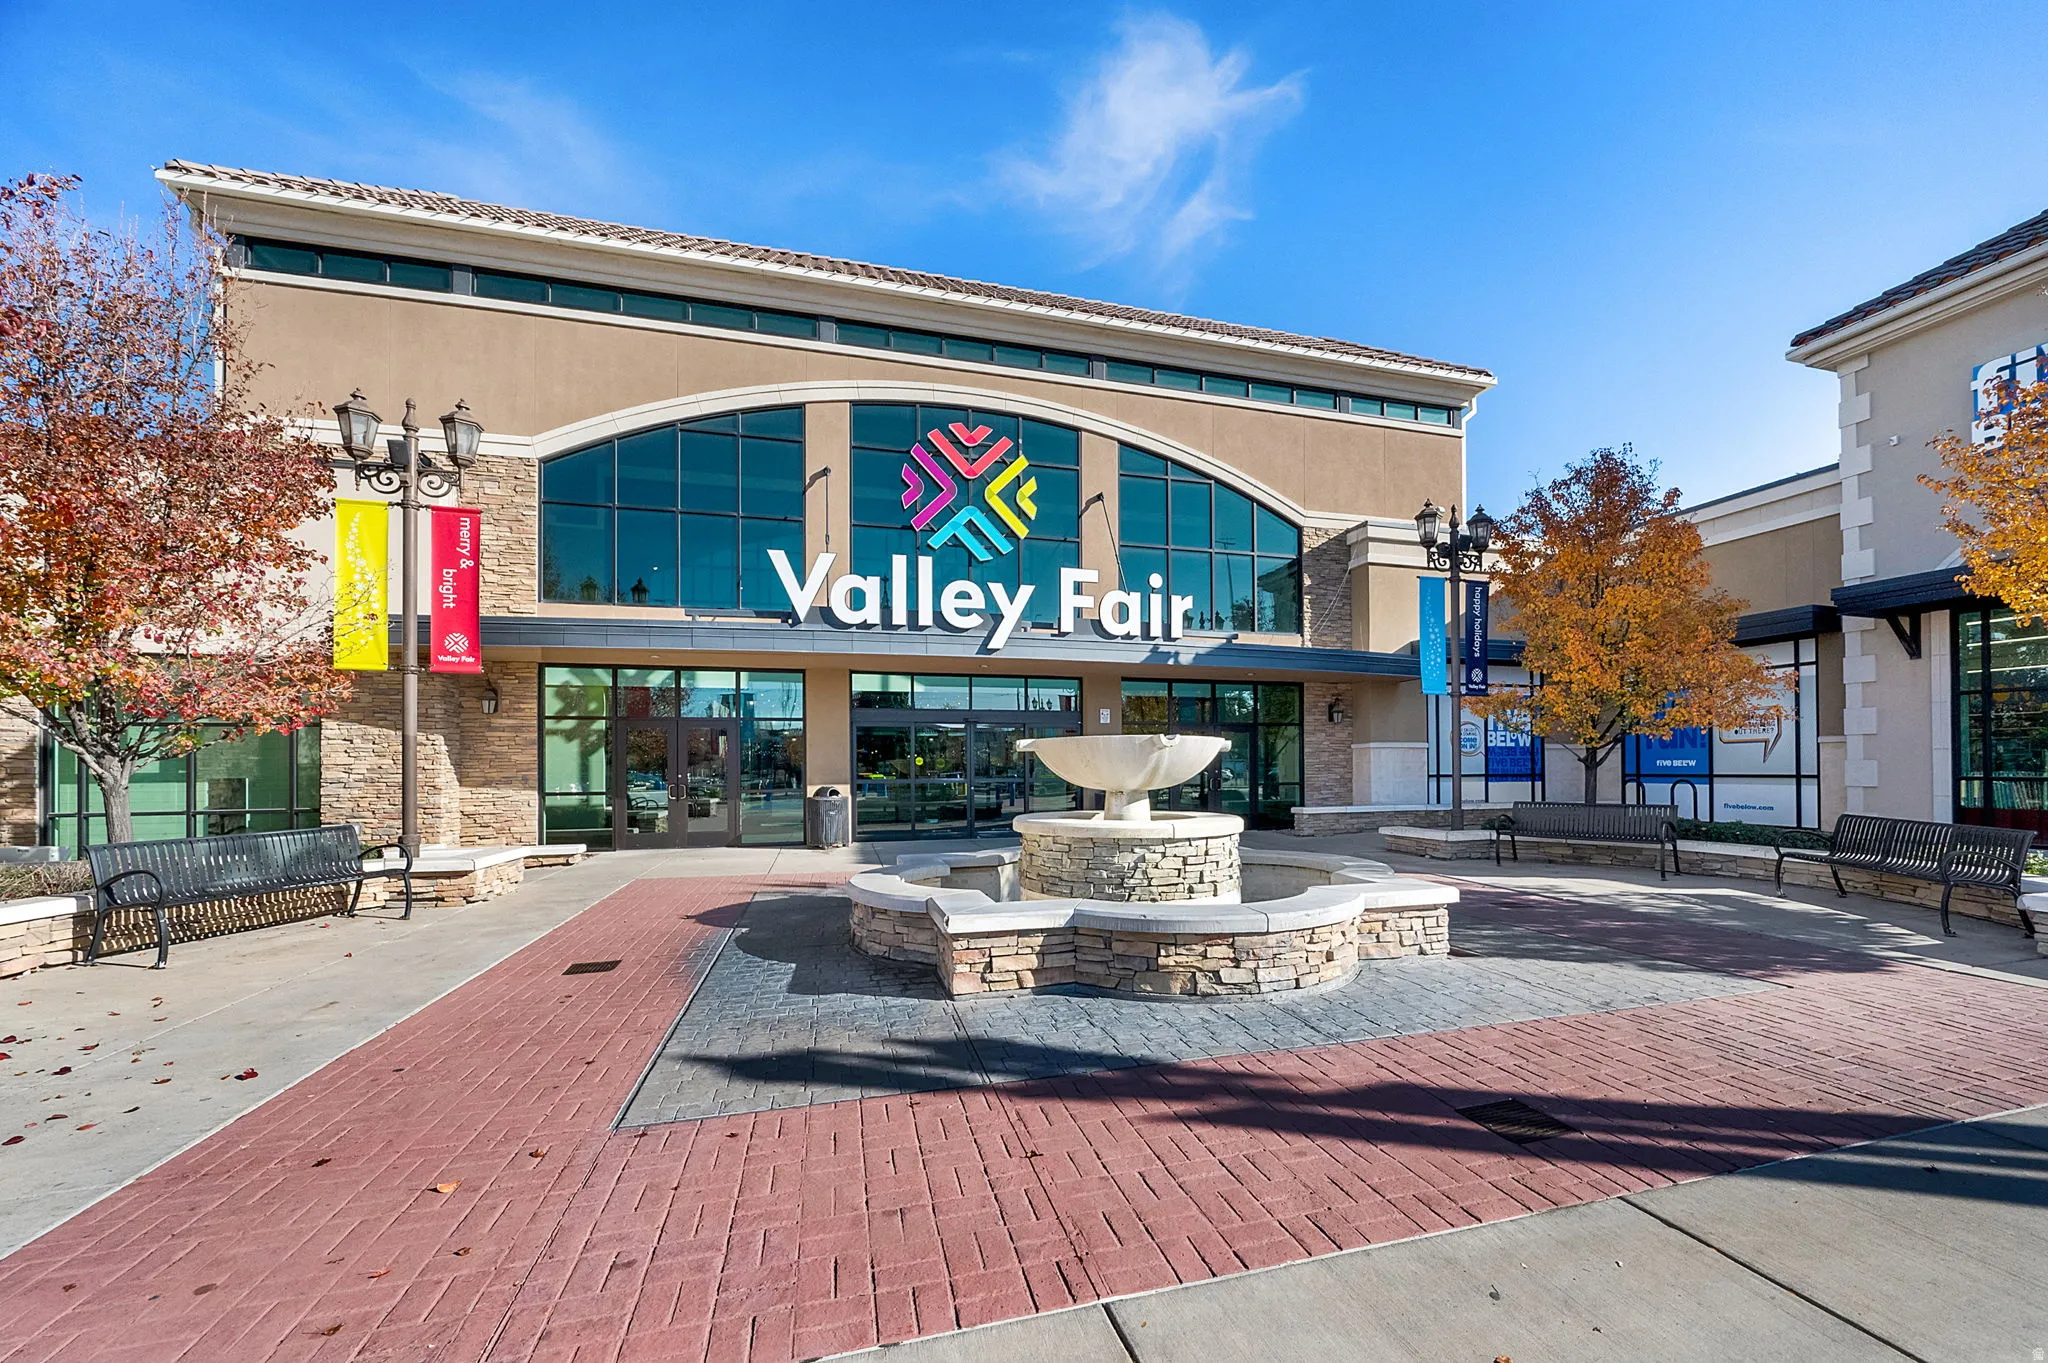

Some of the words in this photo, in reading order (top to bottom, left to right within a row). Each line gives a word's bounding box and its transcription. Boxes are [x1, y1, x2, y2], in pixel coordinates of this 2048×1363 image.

[456, 517, 470, 556] merry
[460, 558, 474, 569] &
[439, 568, 457, 609] bright
[767, 549, 1035, 649] Valley
[1060, 567, 1193, 640] Fair
[1473, 586, 1482, 617] happy
[1473, 618, 1482, 658] holidays
[438, 655, 460, 663] Valley
[1723, 803, 1774, 811] fivebelow.com
